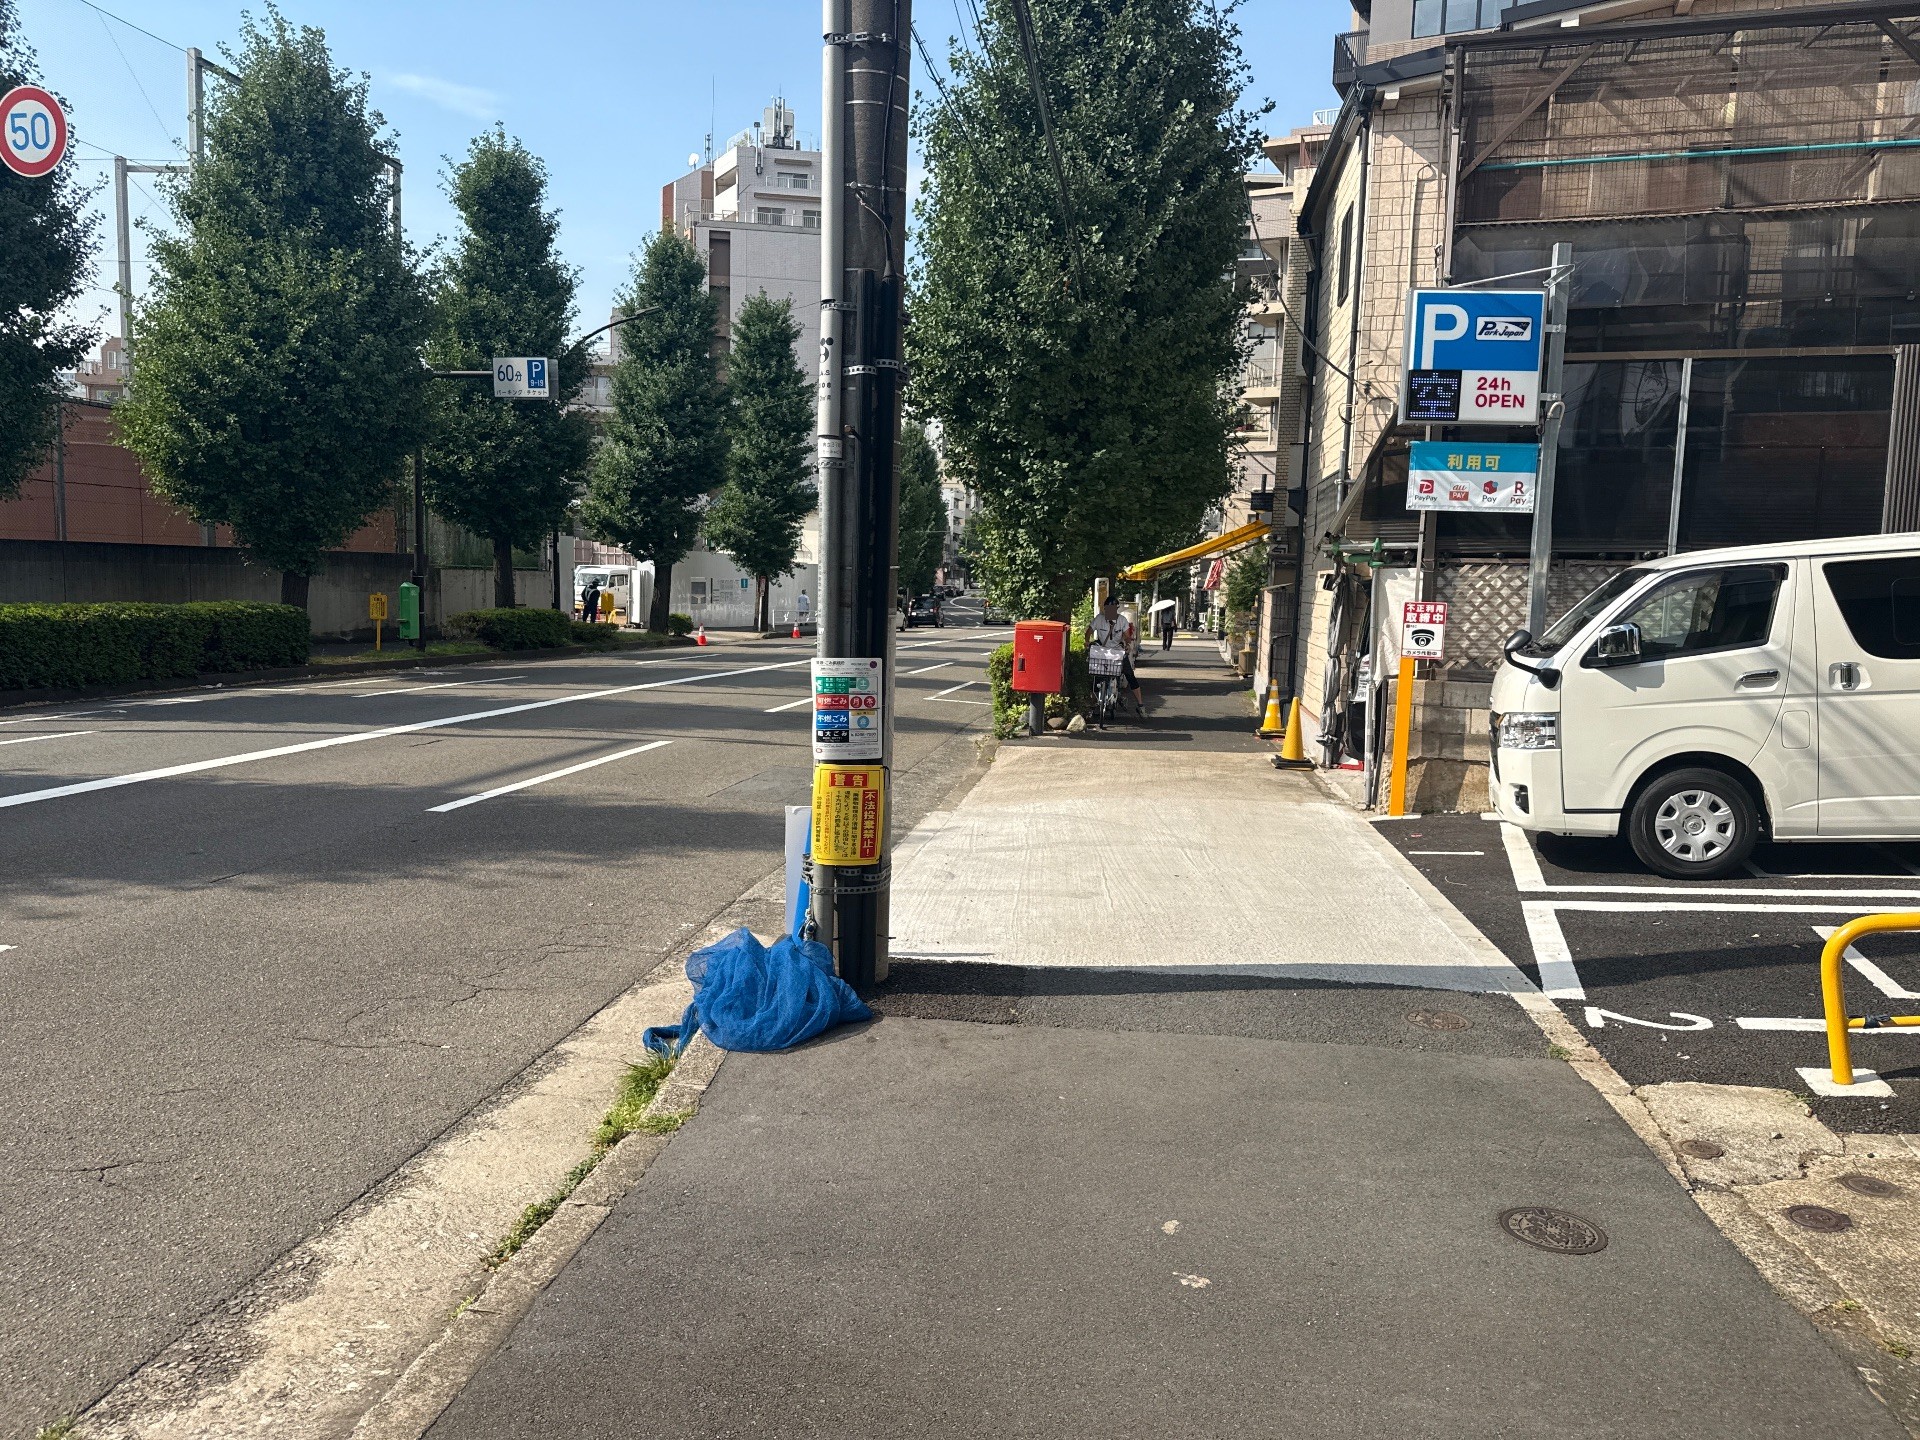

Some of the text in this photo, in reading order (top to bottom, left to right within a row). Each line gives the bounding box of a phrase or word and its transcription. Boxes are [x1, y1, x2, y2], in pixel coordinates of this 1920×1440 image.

[11, 112, 50, 151] 50
[1478, 320, 1525, 338] Park Japan
[1421, 304, 1469, 370] P
[497, 364, 522, 382] 60分
[532, 362, 542, 378] P
[530, 379, 544, 387] 9-19
[1477, 376, 1511, 391] 24h
[1410, 372, 1458, 418] 空
[1475, 393, 1526, 409] OPEN
[1447, 454, 1501, 471] 利用可
[1414, 494, 1438, 503] PayPay
[1482, 494, 1497, 504] Pay
[1510, 497, 1527, 505] Pay
[1406, 603, 1444, 613] 不正利用
[1405, 612, 1444, 623] 取締中
[817, 697, 848, 705] 可燃ごみ
[817, 714, 848, 723] 不燃ごみ
[834, 773, 864, 787] 警告
